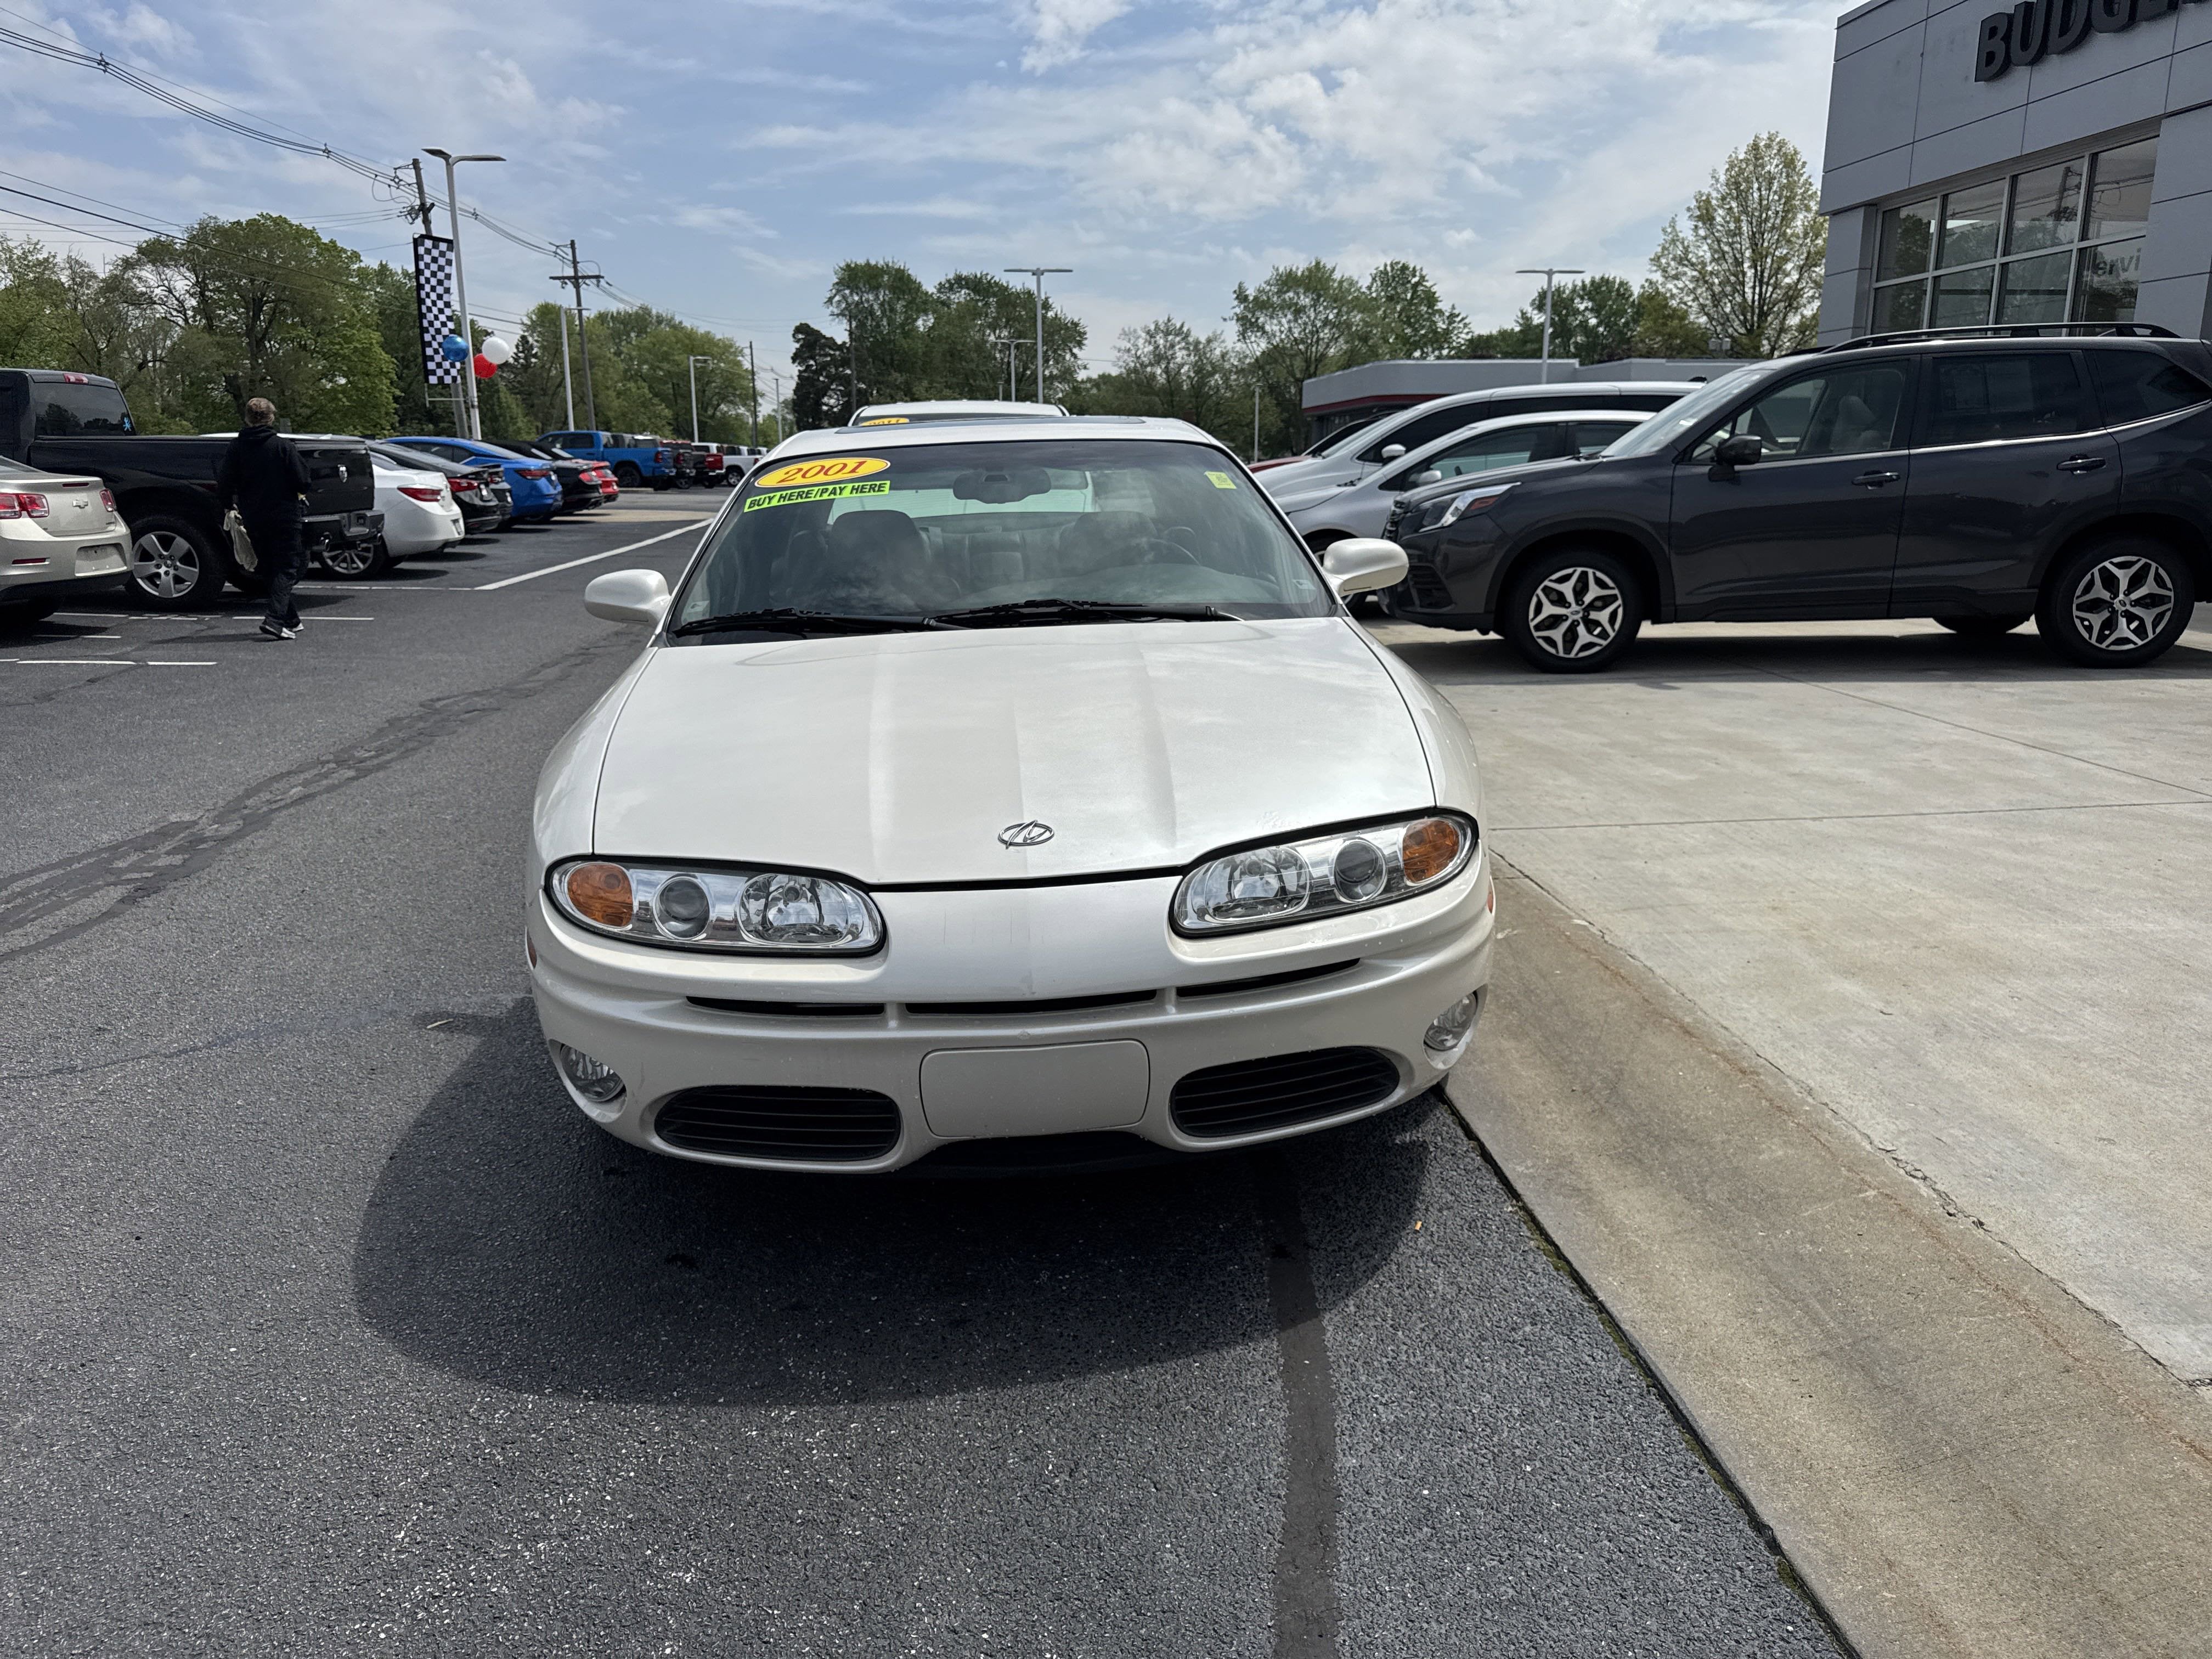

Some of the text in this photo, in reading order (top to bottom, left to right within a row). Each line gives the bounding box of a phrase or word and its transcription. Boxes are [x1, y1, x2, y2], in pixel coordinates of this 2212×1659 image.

[1974, 0, 2209, 82] BUDG
[777, 460, 867, 484] 2001
[747, 483, 887, 510] BUY HERE/PAY HERE
